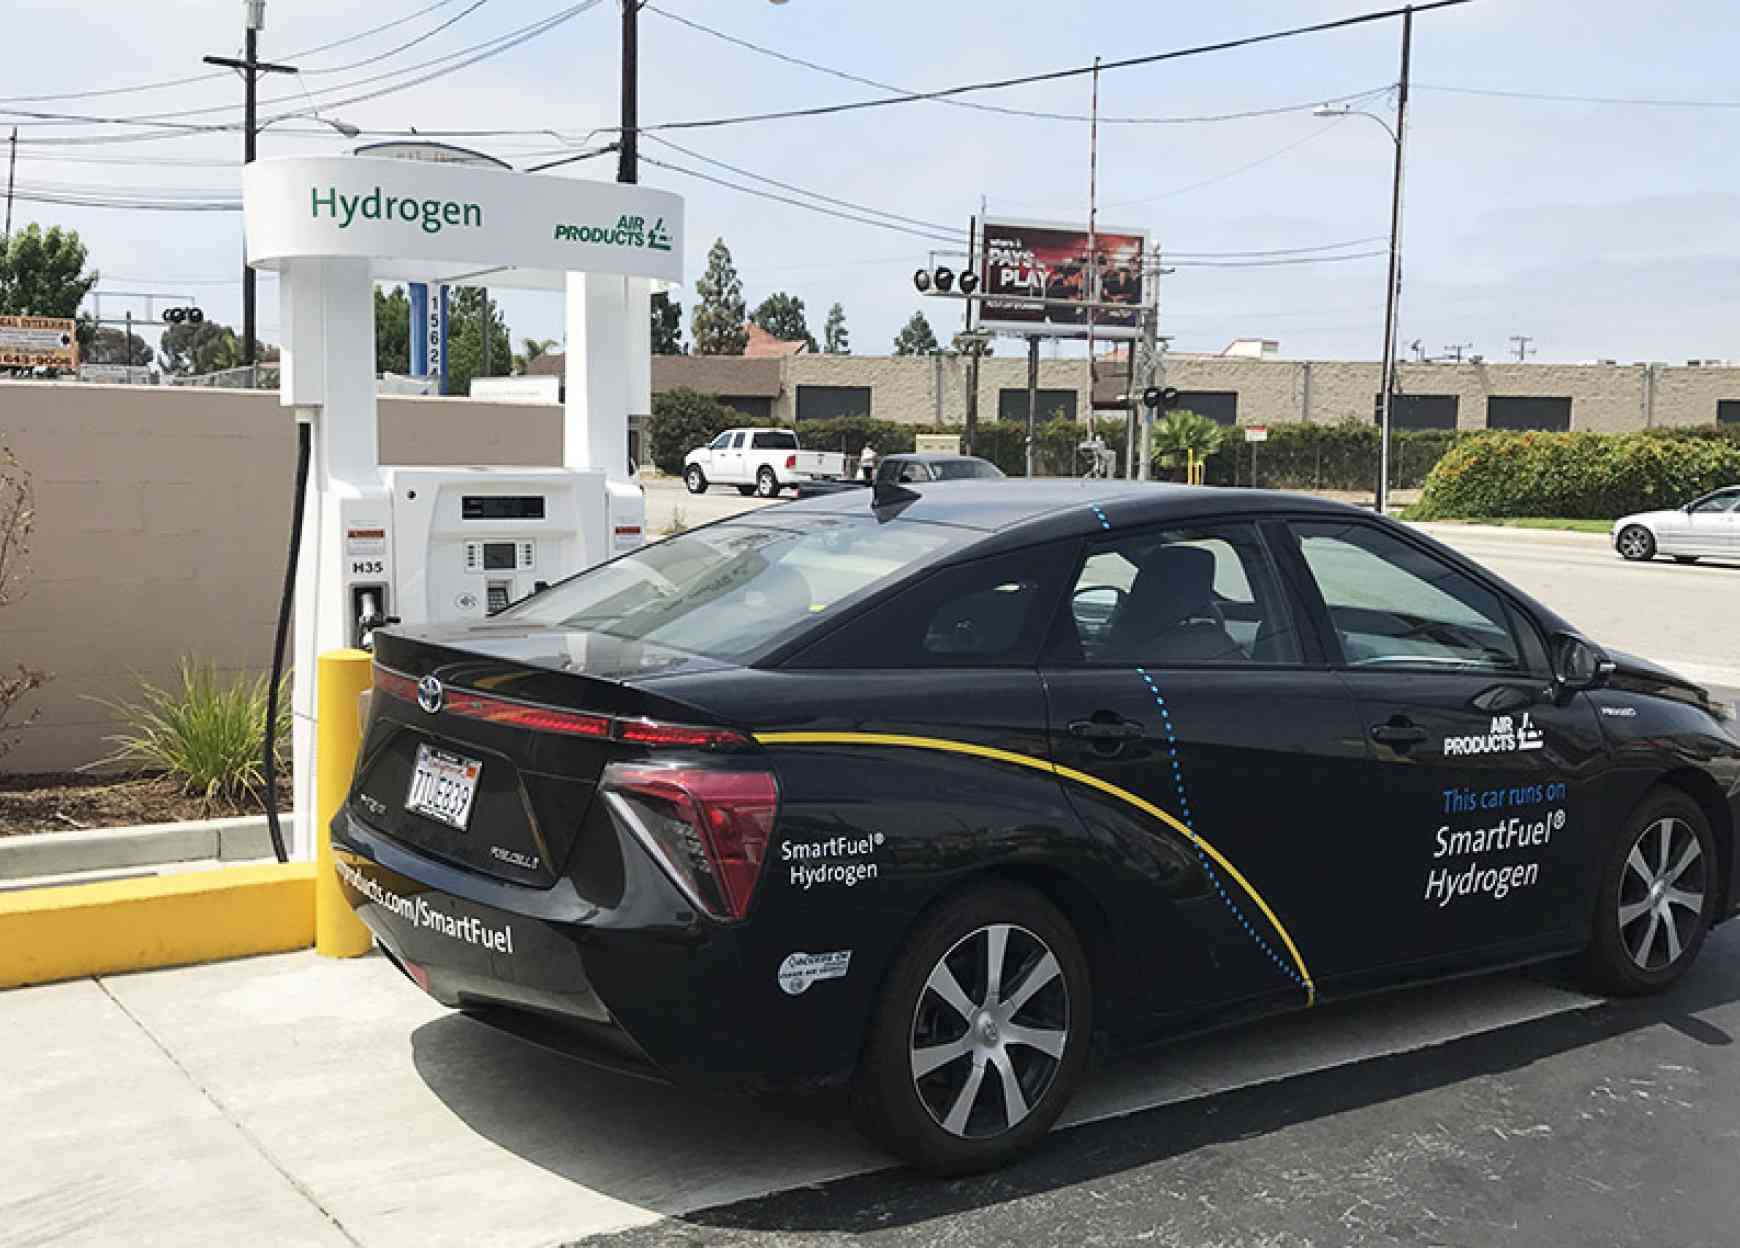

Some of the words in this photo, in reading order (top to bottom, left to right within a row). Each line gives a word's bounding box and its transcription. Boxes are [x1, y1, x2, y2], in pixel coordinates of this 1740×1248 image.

[311, 187, 482, 233] Hydrogen
[617, 215, 645, 231] AIR
[554, 225, 645, 247] PRODUCTS
[1001, 269, 1050, 288] PLAY
[353, 561, 383, 574] H35
[1490, 716, 1513, 734] AIR
[1444, 735, 1516, 755] PRODUCTS
[1443, 789, 1476, 813] This
[1480, 790, 1502, 808] car
[1509, 786, 1543, 806] runs
[1547, 784, 1567, 800] on
[790, 863, 878, 890] Hydrogen
[1425, 863, 1538, 907] Hydrogen
